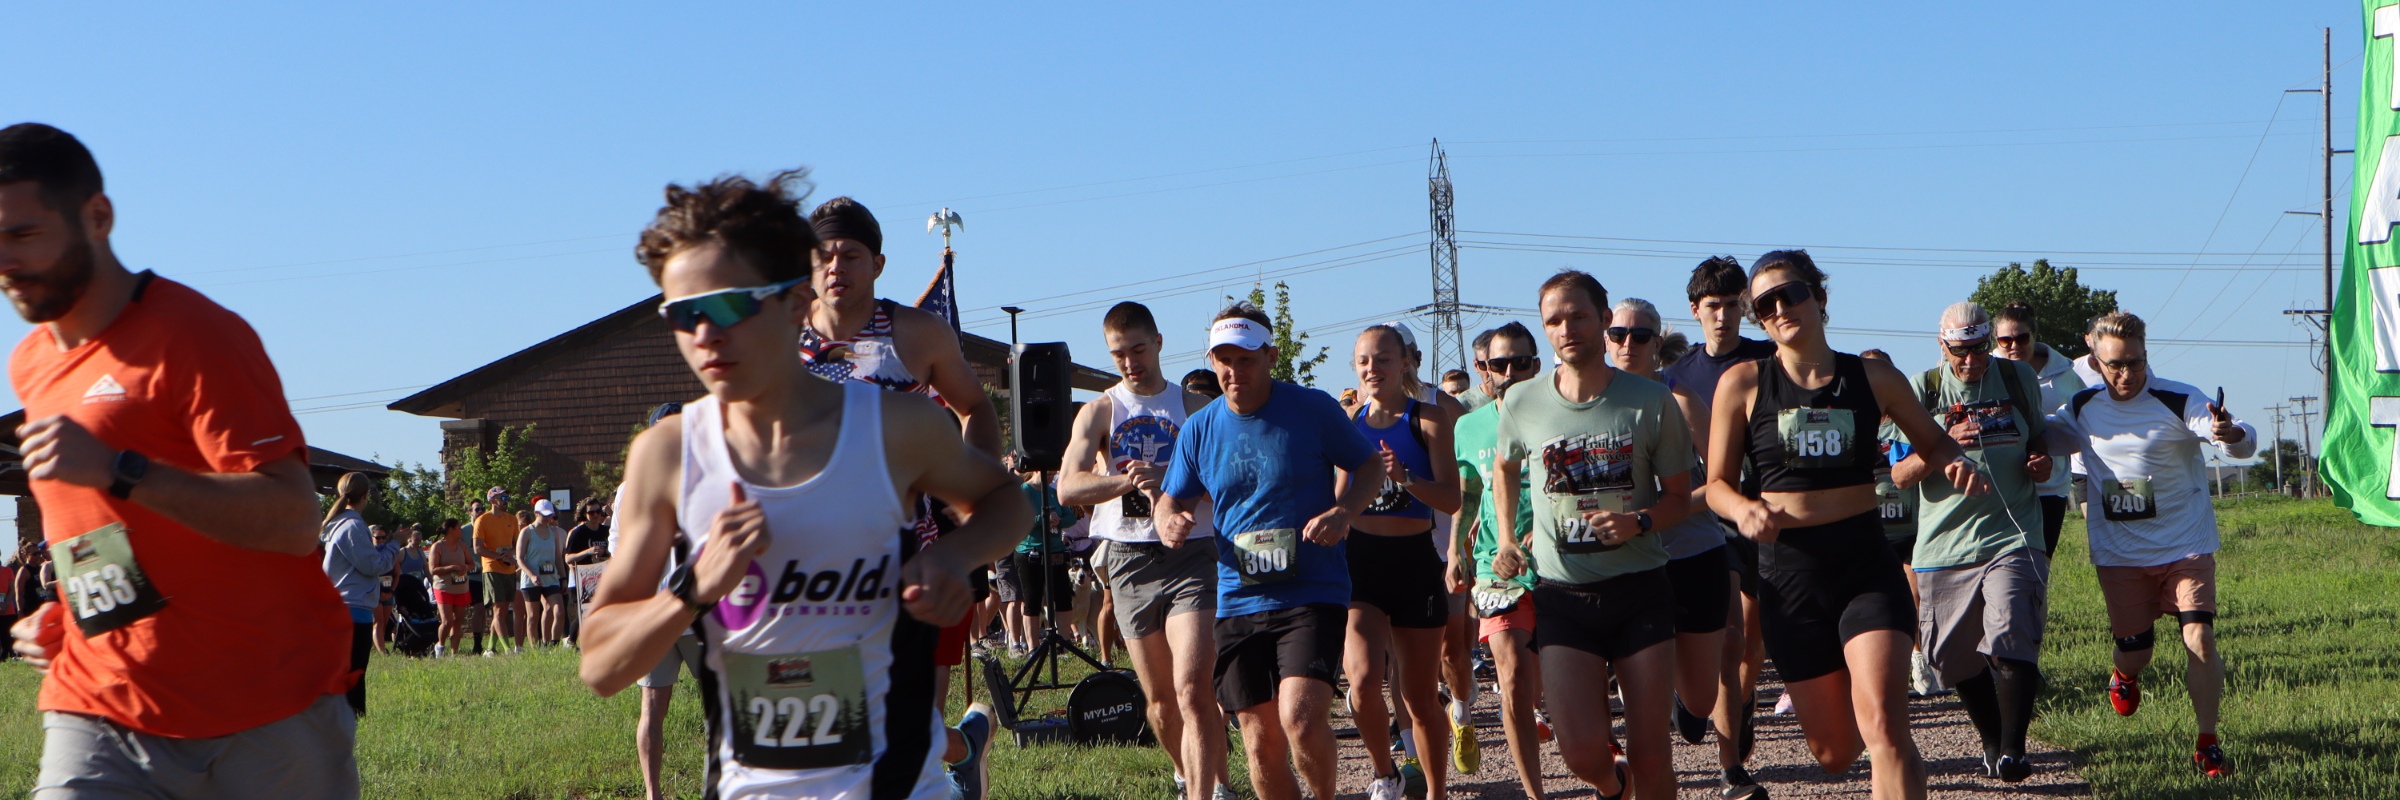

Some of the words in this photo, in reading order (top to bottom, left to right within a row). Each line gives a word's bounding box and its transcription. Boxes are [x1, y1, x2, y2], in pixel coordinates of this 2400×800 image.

[1121, 416, 1156, 432] SPACE
[1794, 429, 1841, 457] 158
[1581, 450, 1633, 465] Recovery
[1879, 502, 1904, 519] 161
[2110, 494, 2146, 513] 240
[1565, 517, 1597, 543] 22
[1244, 547, 1287, 575] 300
[770, 554, 891, 604] bold.
[67, 563, 138, 620] 253
[768, 605, 871, 617] RUNNING
[750, 693, 843, 748] 222
[1083, 702, 1133, 721] MYLAPS
